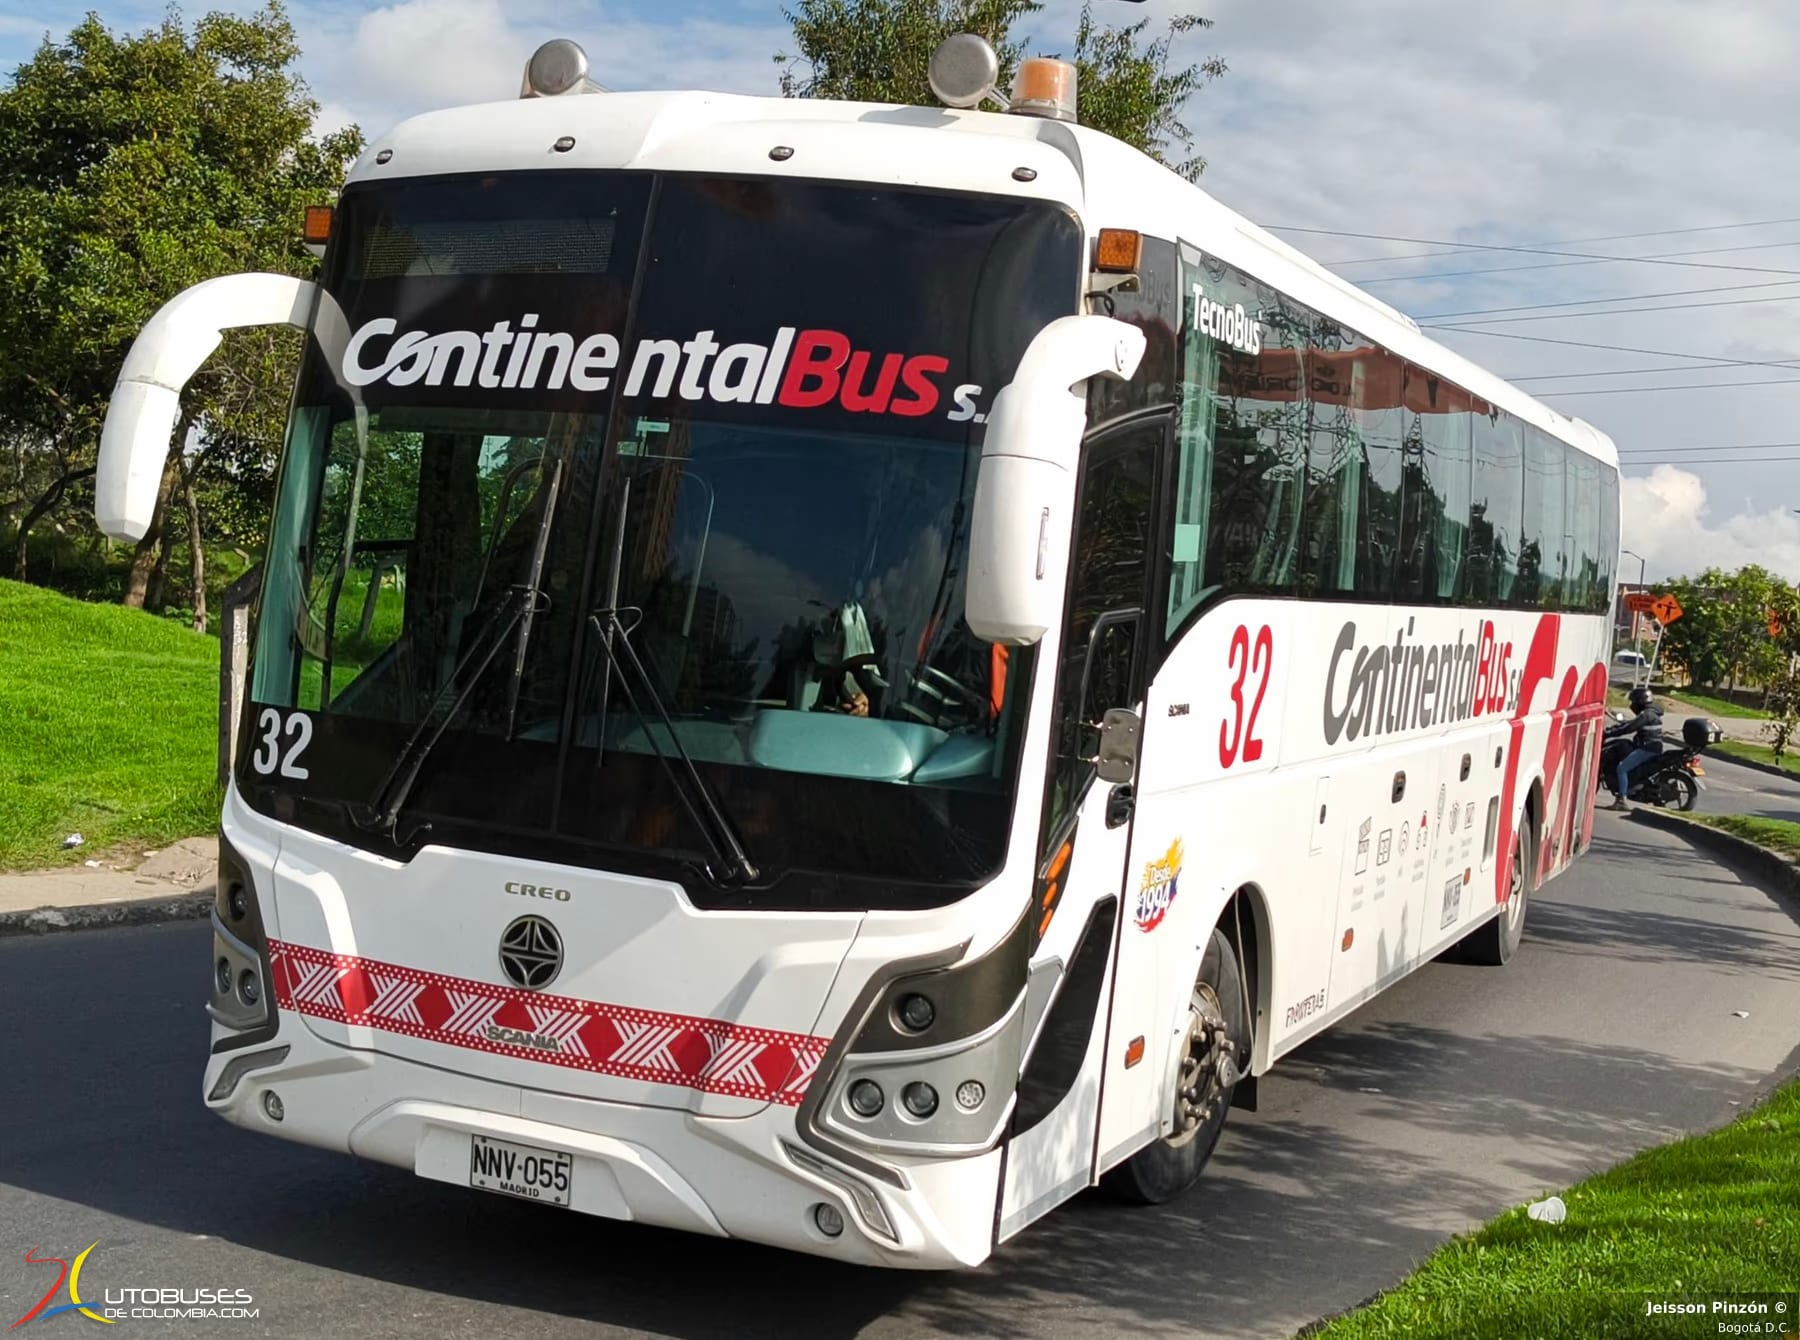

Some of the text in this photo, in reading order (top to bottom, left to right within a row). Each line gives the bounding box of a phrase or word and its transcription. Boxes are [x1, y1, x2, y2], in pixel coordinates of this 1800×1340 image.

[1192, 282, 1260, 355] TecnoBus
[947, 384, 988, 424] S.
[1219, 624, 1273, 769] 32
[1323, 616, 1513, 746] ContinentalBus
[253, 707, 313, 780] 32
[504, 881, 572, 902] CREO
[486, 1025, 561, 1051] SCANIA
[499, 1181, 540, 1198] MADRID
